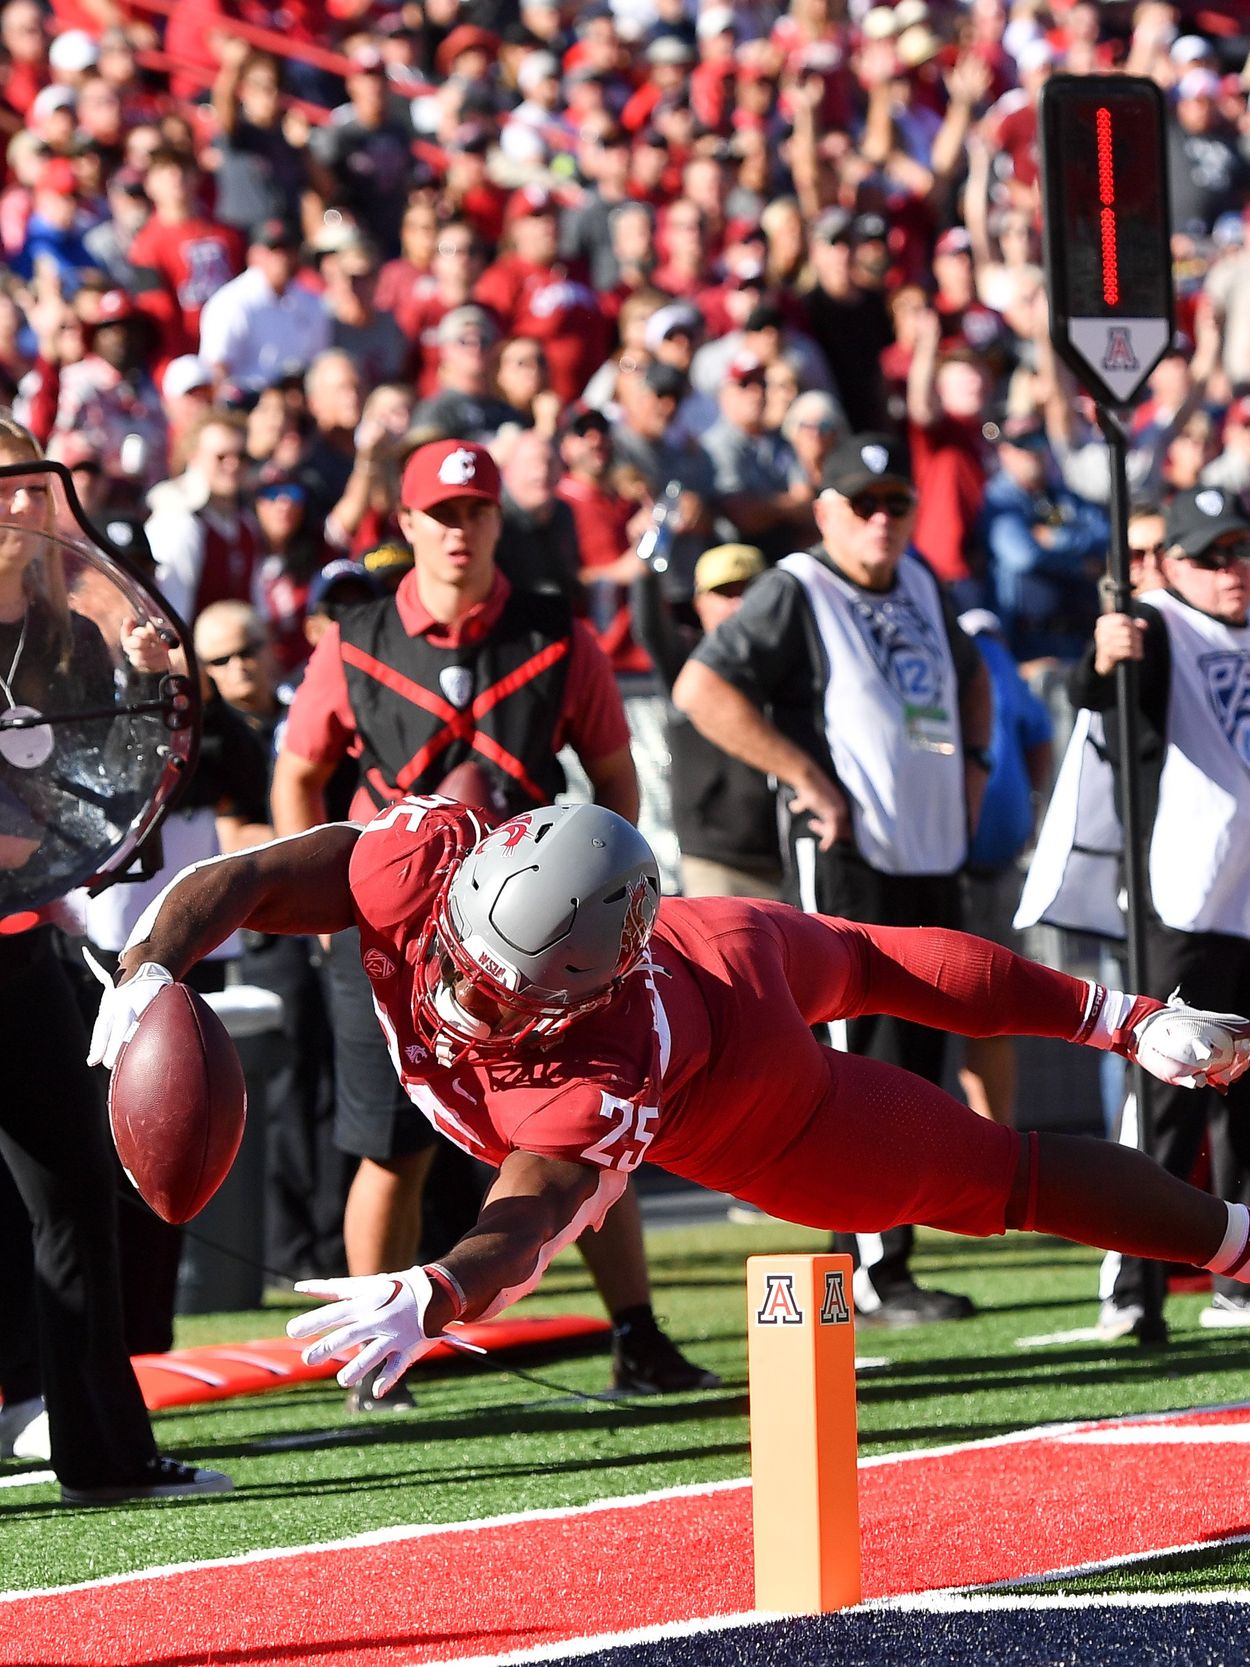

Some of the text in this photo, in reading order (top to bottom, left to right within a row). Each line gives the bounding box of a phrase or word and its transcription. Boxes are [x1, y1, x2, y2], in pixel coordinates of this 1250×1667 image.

[1103, 325, 1140, 372] A
[895, 658, 929, 694] 12
[1091, 984, 1105, 1018] GRIP
[580, 1089, 660, 1174] 25
[757, 1272, 851, 1325] A A
